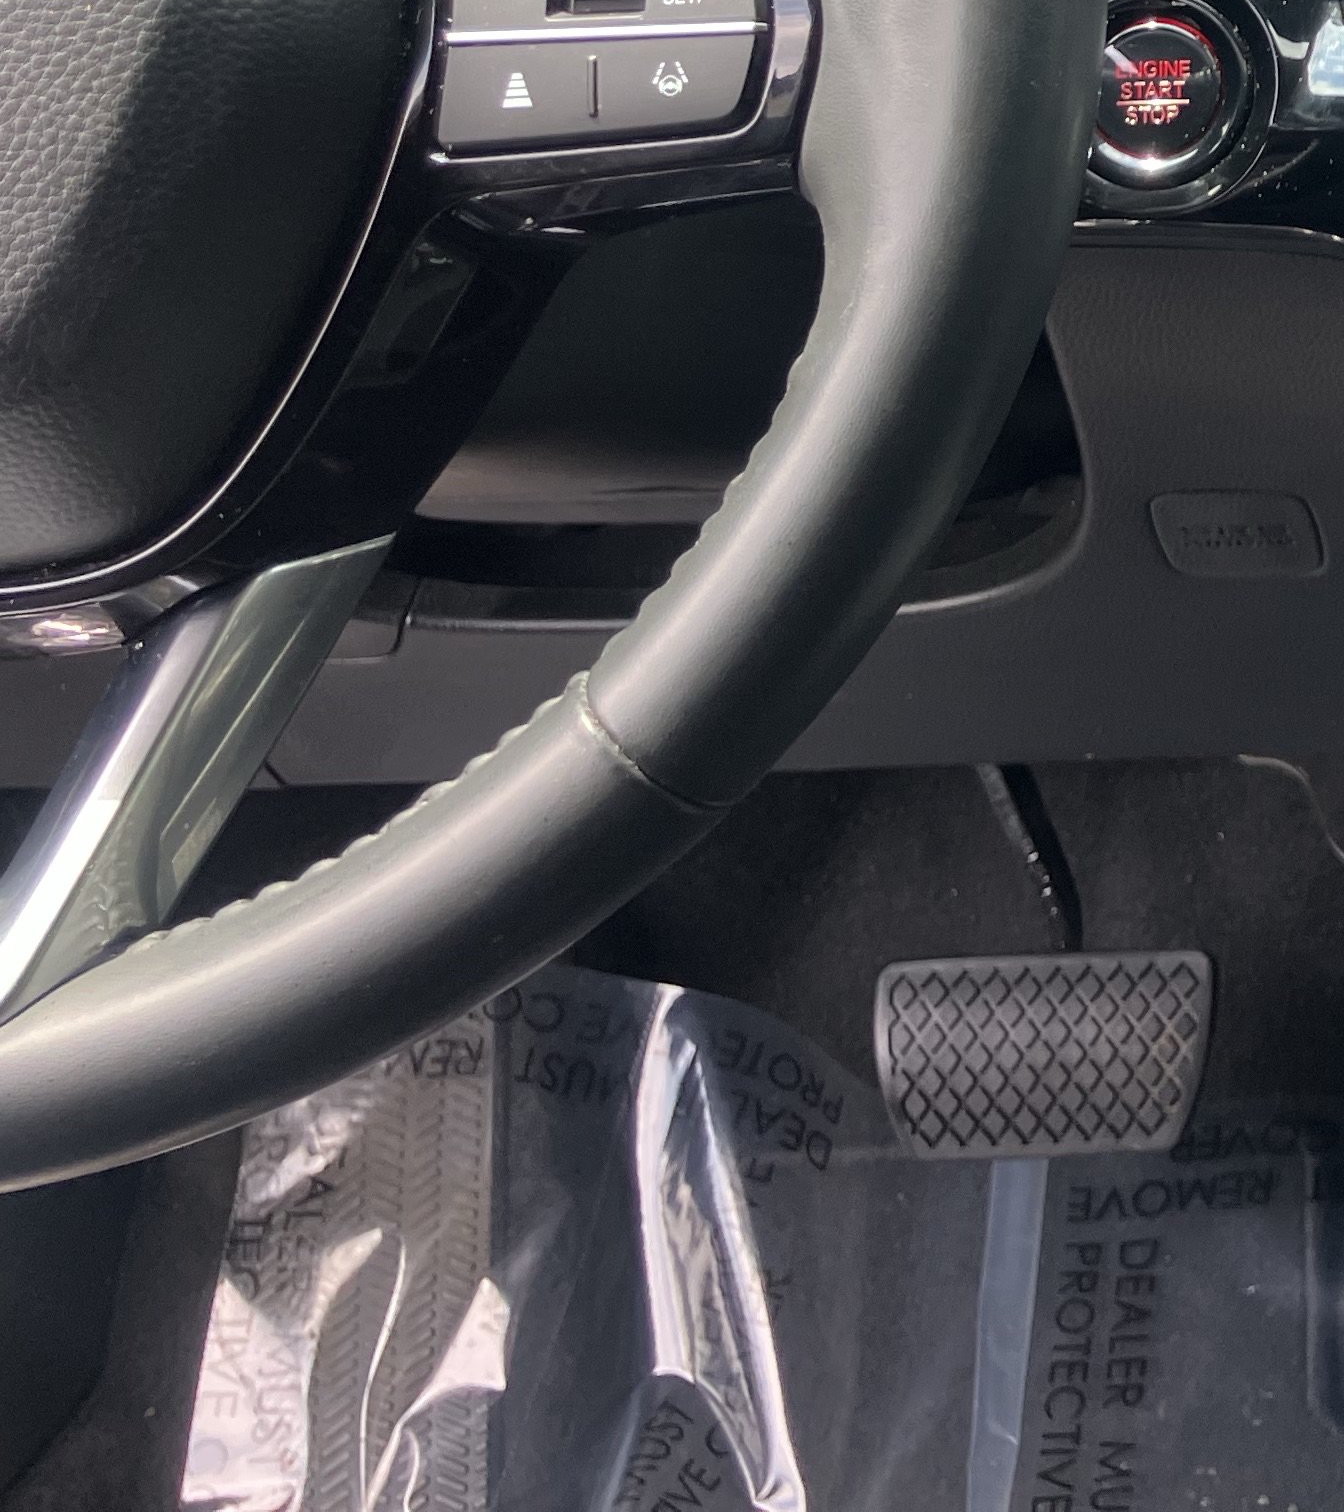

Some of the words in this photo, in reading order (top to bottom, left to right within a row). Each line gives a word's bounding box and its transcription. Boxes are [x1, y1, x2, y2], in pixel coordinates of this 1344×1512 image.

[1115, 59, 1191, 79] ENGINE
[1120, 81, 1185, 100] START
[1125, 105, 1179, 125] STOP
[1102, 1238, 1158, 1409] DEALER
